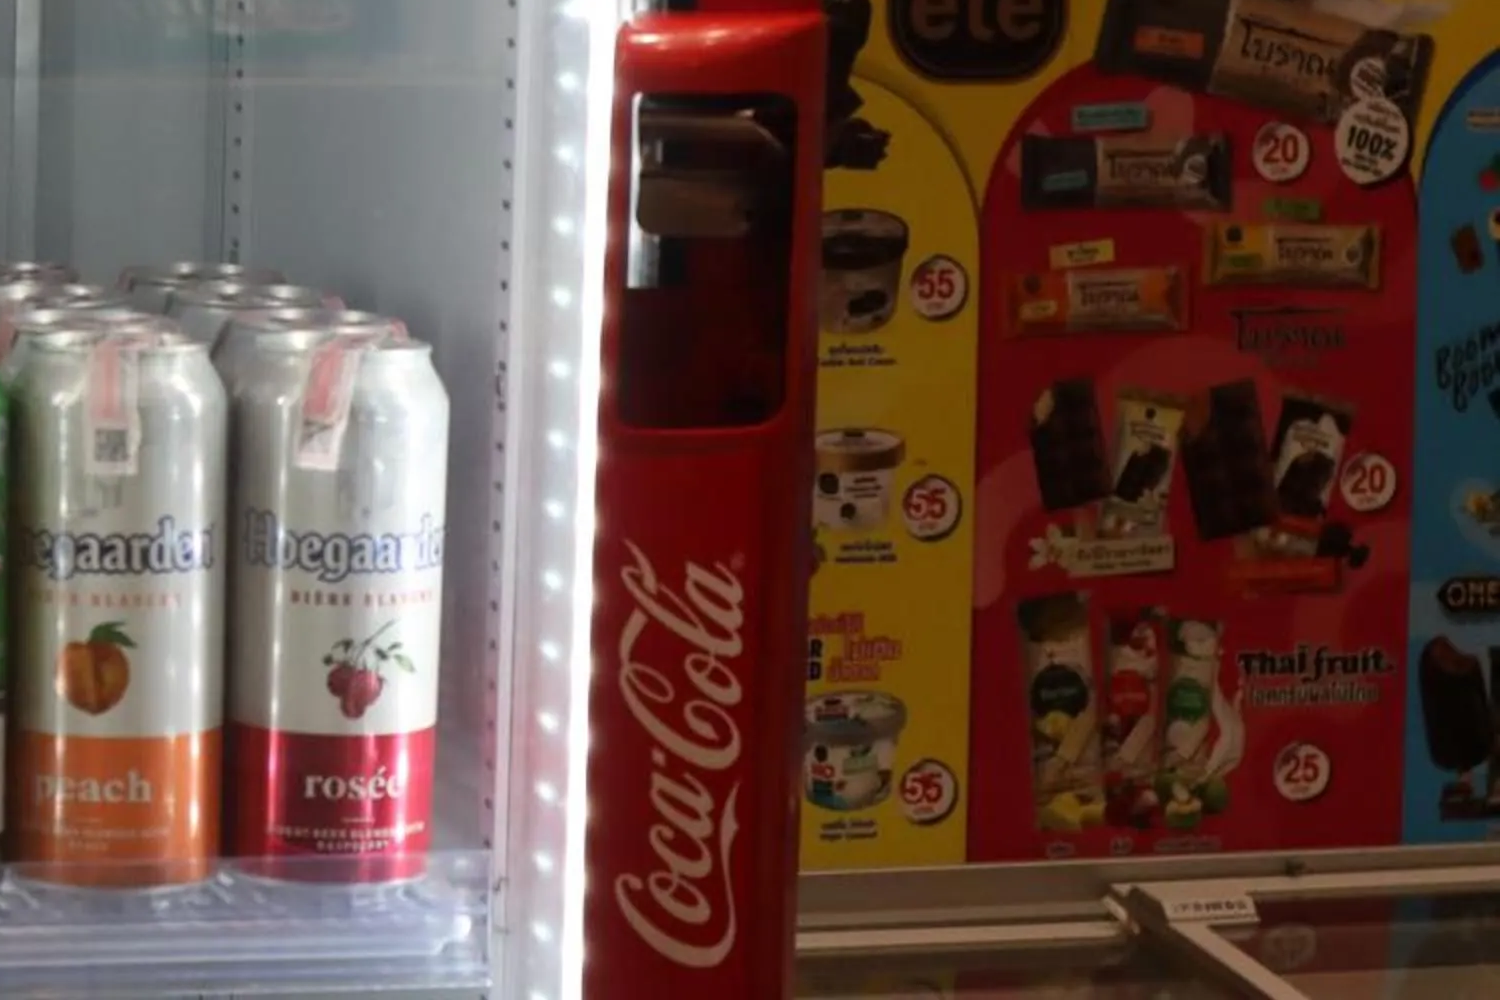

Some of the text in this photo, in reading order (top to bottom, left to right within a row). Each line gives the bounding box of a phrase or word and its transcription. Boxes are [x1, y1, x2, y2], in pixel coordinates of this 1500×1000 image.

[1262, 134, 1299, 164] 20
[1347, 125, 1398, 162] 100%
[916, 268, 955, 299] 55
[1349, 463, 1386, 495] 20
[906, 489, 947, 520] 55
[613, 539, 745, 968] Coca-Cola
[1285, 754, 1319, 784] 25
[37, 769, 153, 805] peach
[901, 774, 945, 804] 55
